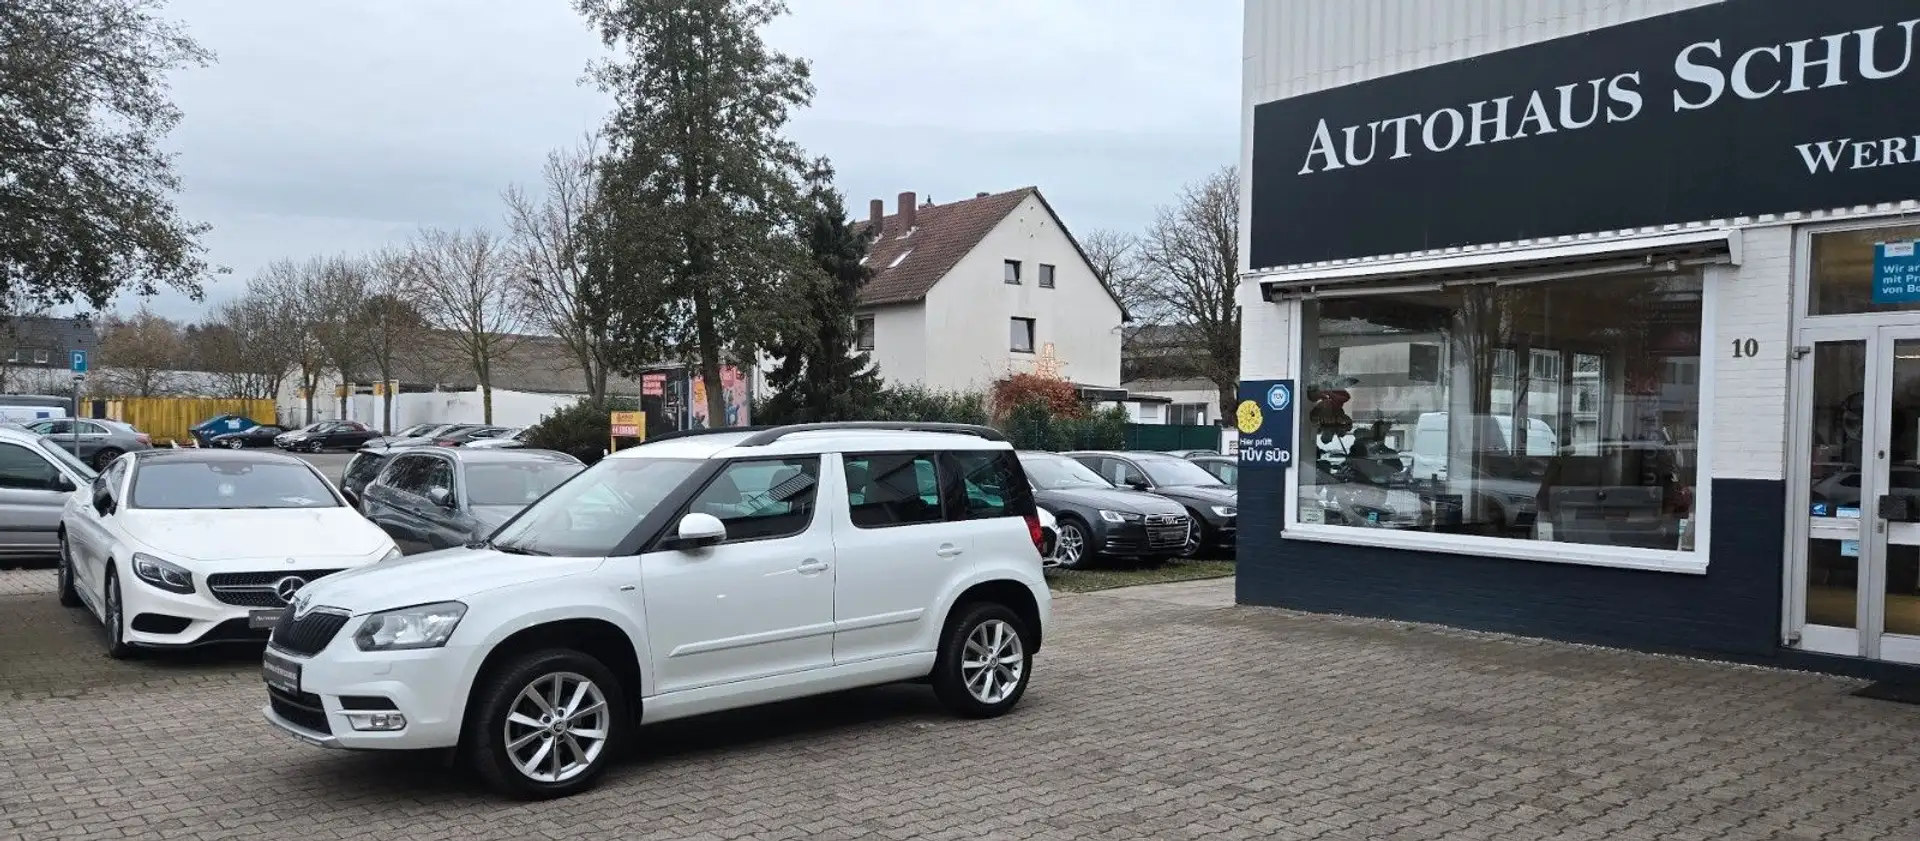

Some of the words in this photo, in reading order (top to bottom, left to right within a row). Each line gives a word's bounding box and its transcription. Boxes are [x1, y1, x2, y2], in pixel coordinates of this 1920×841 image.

[1297, 71, 1643, 175] AUTOHAUS
[1673, 19, 1920, 112] SCHU
[1883, 264, 1904, 273] Wir
[1882, 275, 1902, 284] mit
[1882, 286, 1903, 294] von
[1732, 338, 1759, 358] 10
[74, 353, 83, 369] P
[1240, 447, 1263, 462] TÜV
[1265, 447, 1290, 462] SÜD
